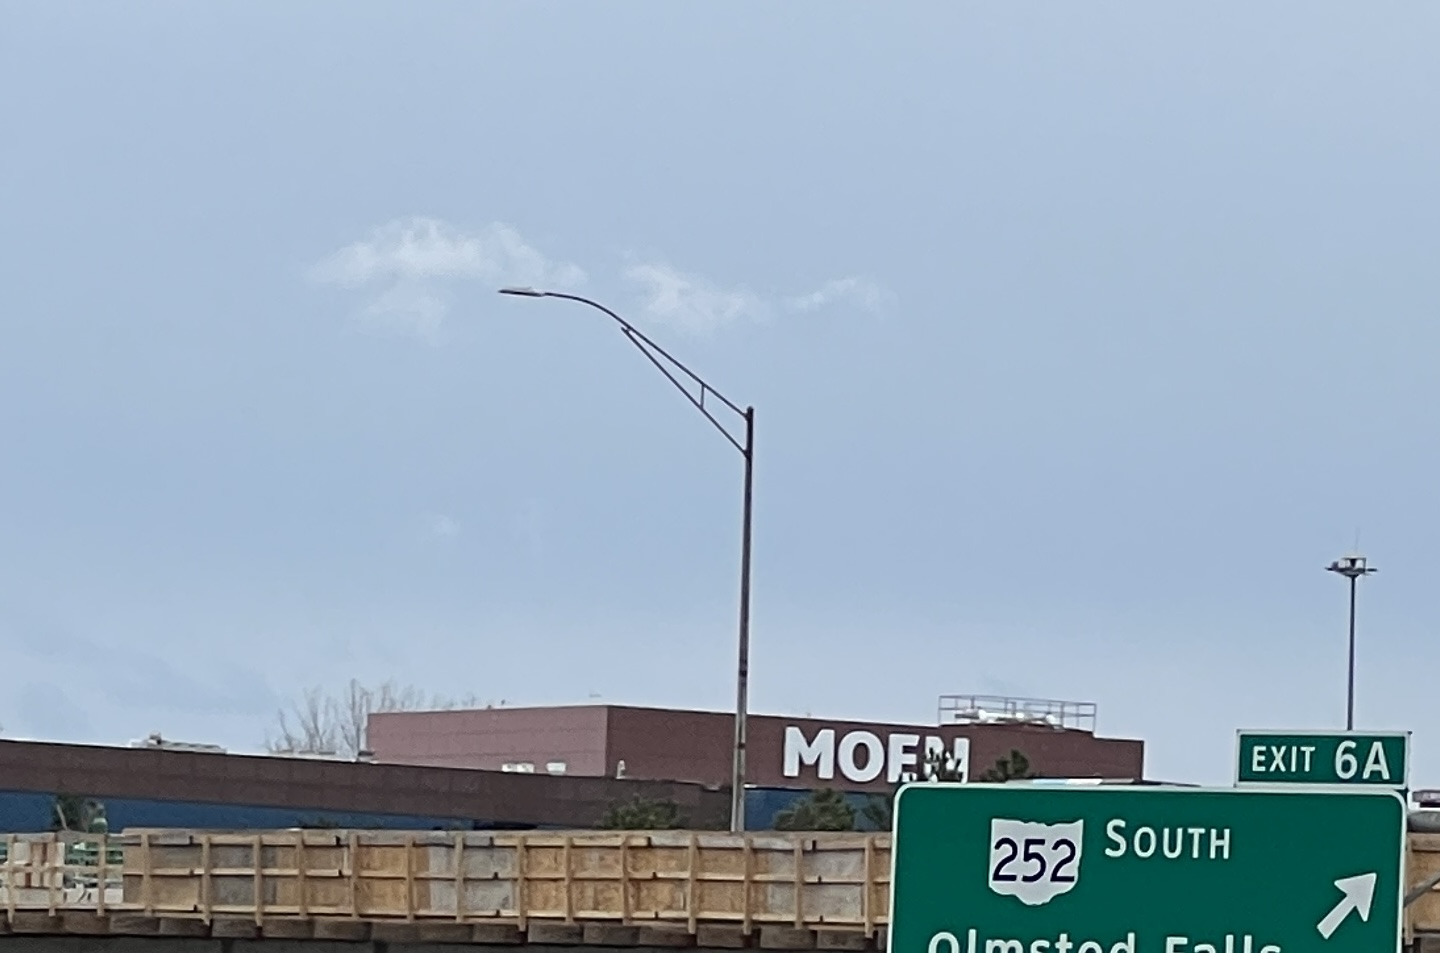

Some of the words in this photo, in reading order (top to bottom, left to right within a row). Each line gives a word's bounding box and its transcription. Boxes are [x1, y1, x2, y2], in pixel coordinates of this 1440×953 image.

[783, 726, 970, 784] MOEN
[1252, 745, 1316, 772] EXIT
[1335, 740, 1390, 780] 6A
[992, 837, 1077, 883] 252
[1104, 818, 1231, 860] SOUTH
